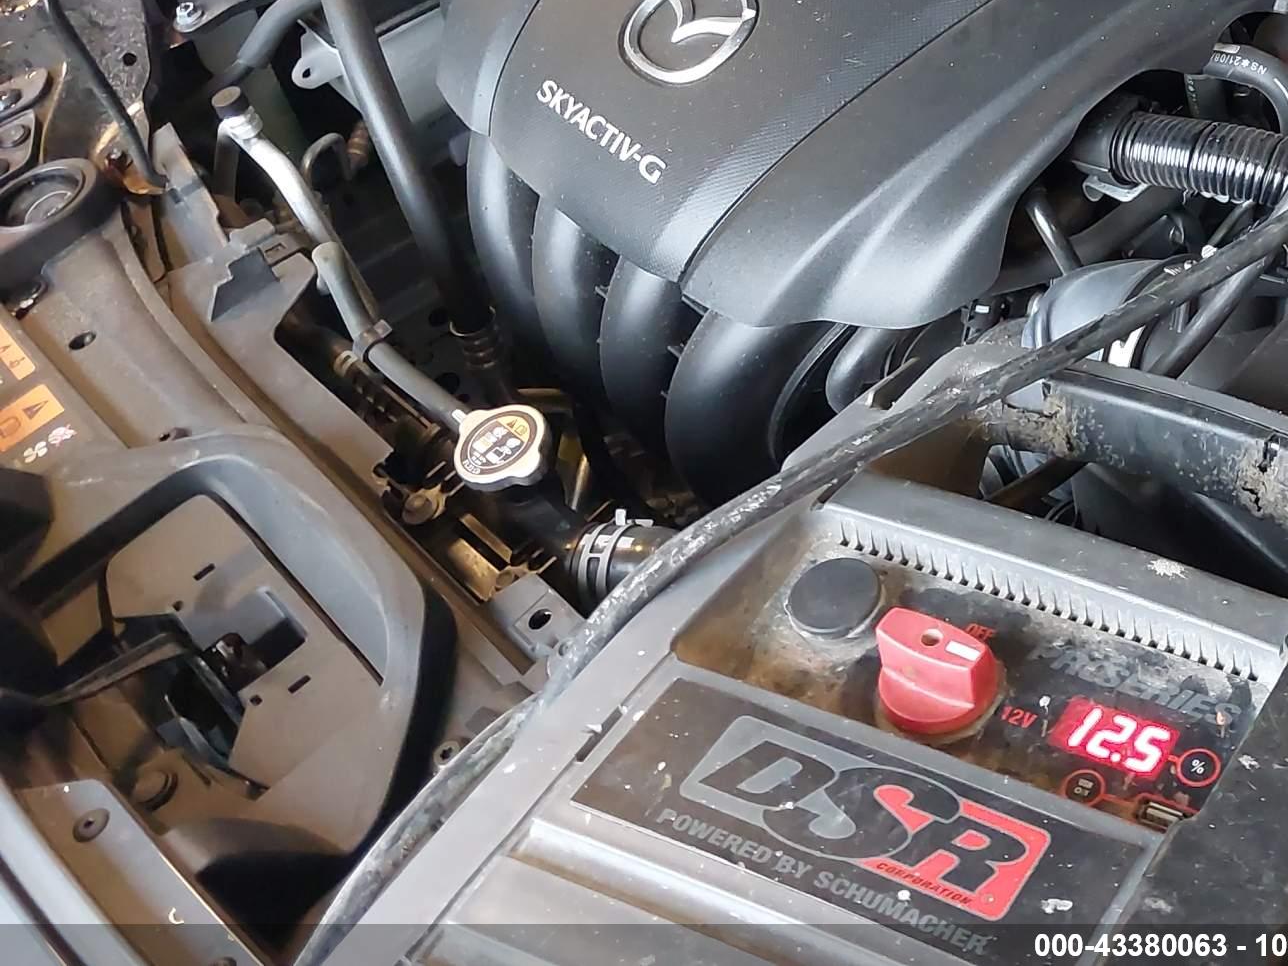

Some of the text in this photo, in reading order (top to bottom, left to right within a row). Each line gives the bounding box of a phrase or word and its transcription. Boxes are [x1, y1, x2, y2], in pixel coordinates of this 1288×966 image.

[536, 80, 667, 184] SKYACTIV-G
[1000, 705, 1038, 728] 12V
[1067, 707, 1171, 773] 12.5
[697, 740, 1028, 892] DSR
[656, 808, 989, 955] POWERED BY SCHUMACHER
[876, 862, 973, 905] CORPORATION
